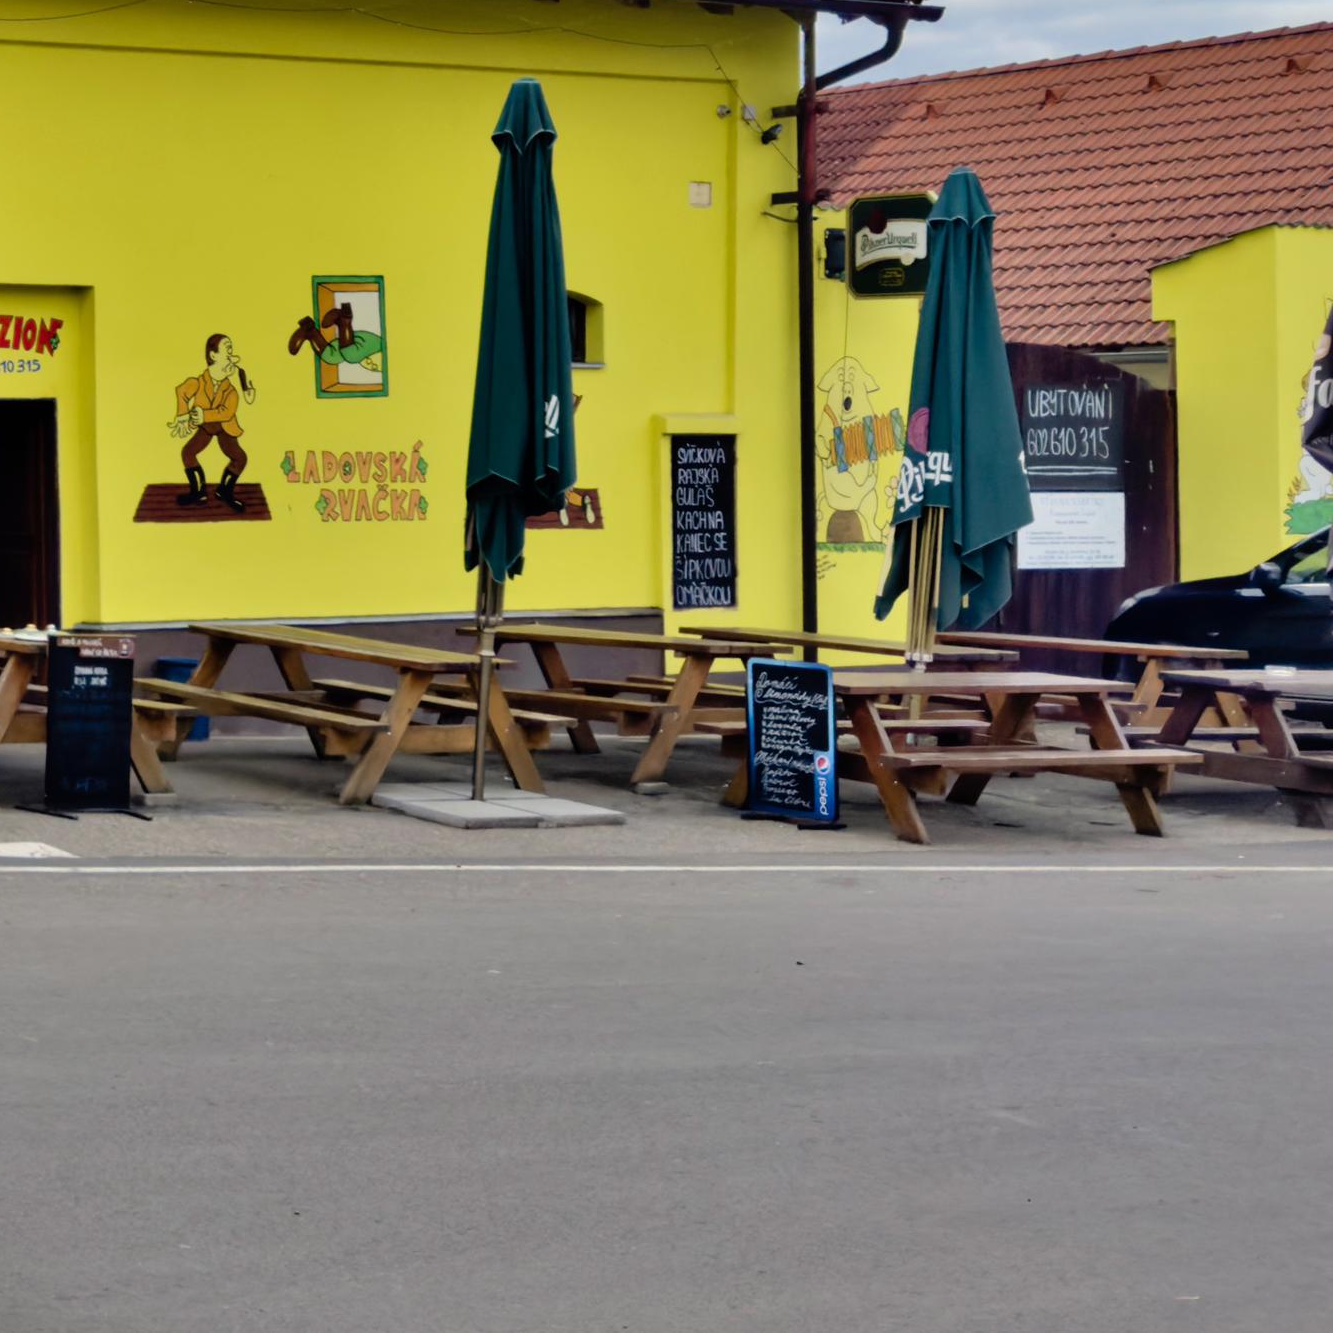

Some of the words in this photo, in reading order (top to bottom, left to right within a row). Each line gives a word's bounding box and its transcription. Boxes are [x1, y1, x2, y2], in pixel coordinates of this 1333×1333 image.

[17, 358, 41, 373] 315
[1079, 426, 1110, 459] 315
[283, 440, 427, 483] LADOVSKÁ
[319, 484, 428, 522] RVAČKA
[677, 511, 724, 530] KACHNA
[677, 533, 712, 553] KANEC
[714, 532, 728, 551] SE
[818, 777, 830, 816] pepsi
